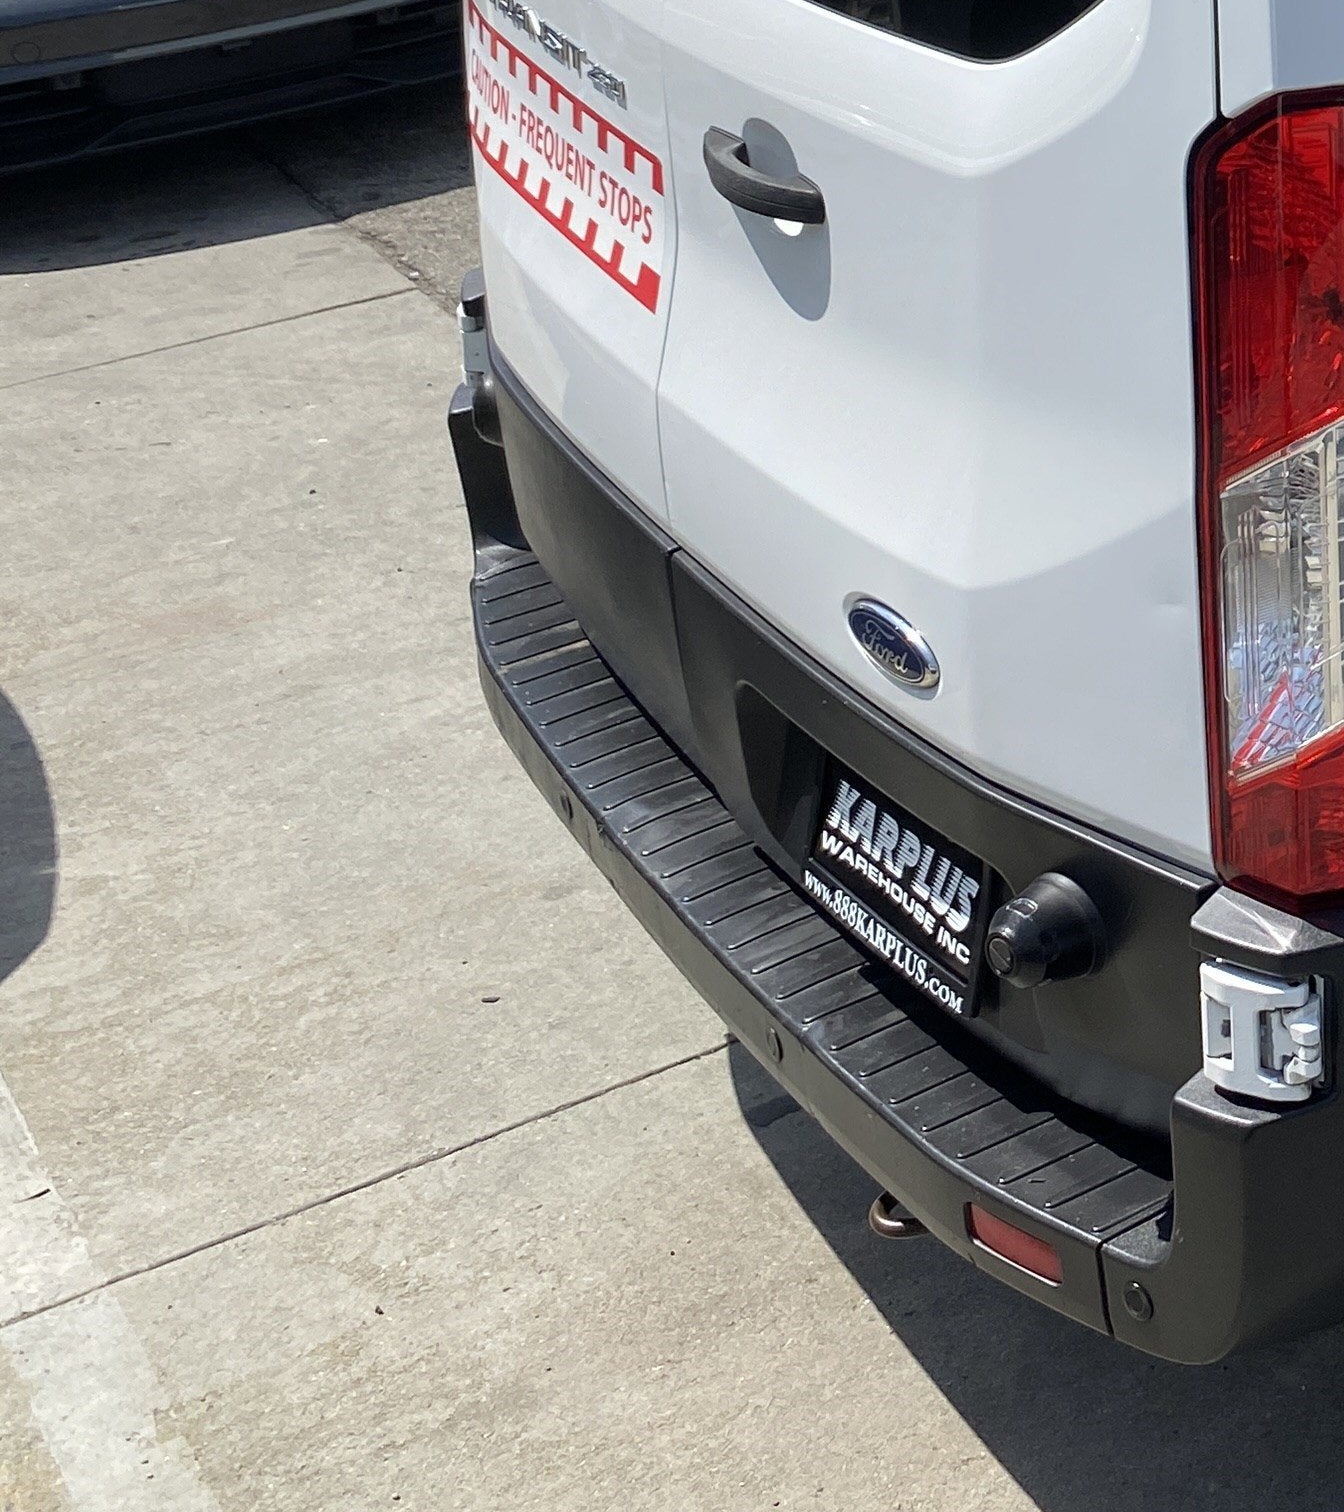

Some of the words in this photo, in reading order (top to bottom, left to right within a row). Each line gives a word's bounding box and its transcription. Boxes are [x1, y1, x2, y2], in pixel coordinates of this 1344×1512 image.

[472, 48, 510, 125] CAUTION
[518, 102, 596, 197] FREQUENT
[598, 170, 653, 245] STOPS
[861, 619, 909, 674] Ford
[820, 830, 937, 936] WAREHOUSE
[935, 925, 971, 965] INC
[825, 778, 980, 933] KARPLUS
